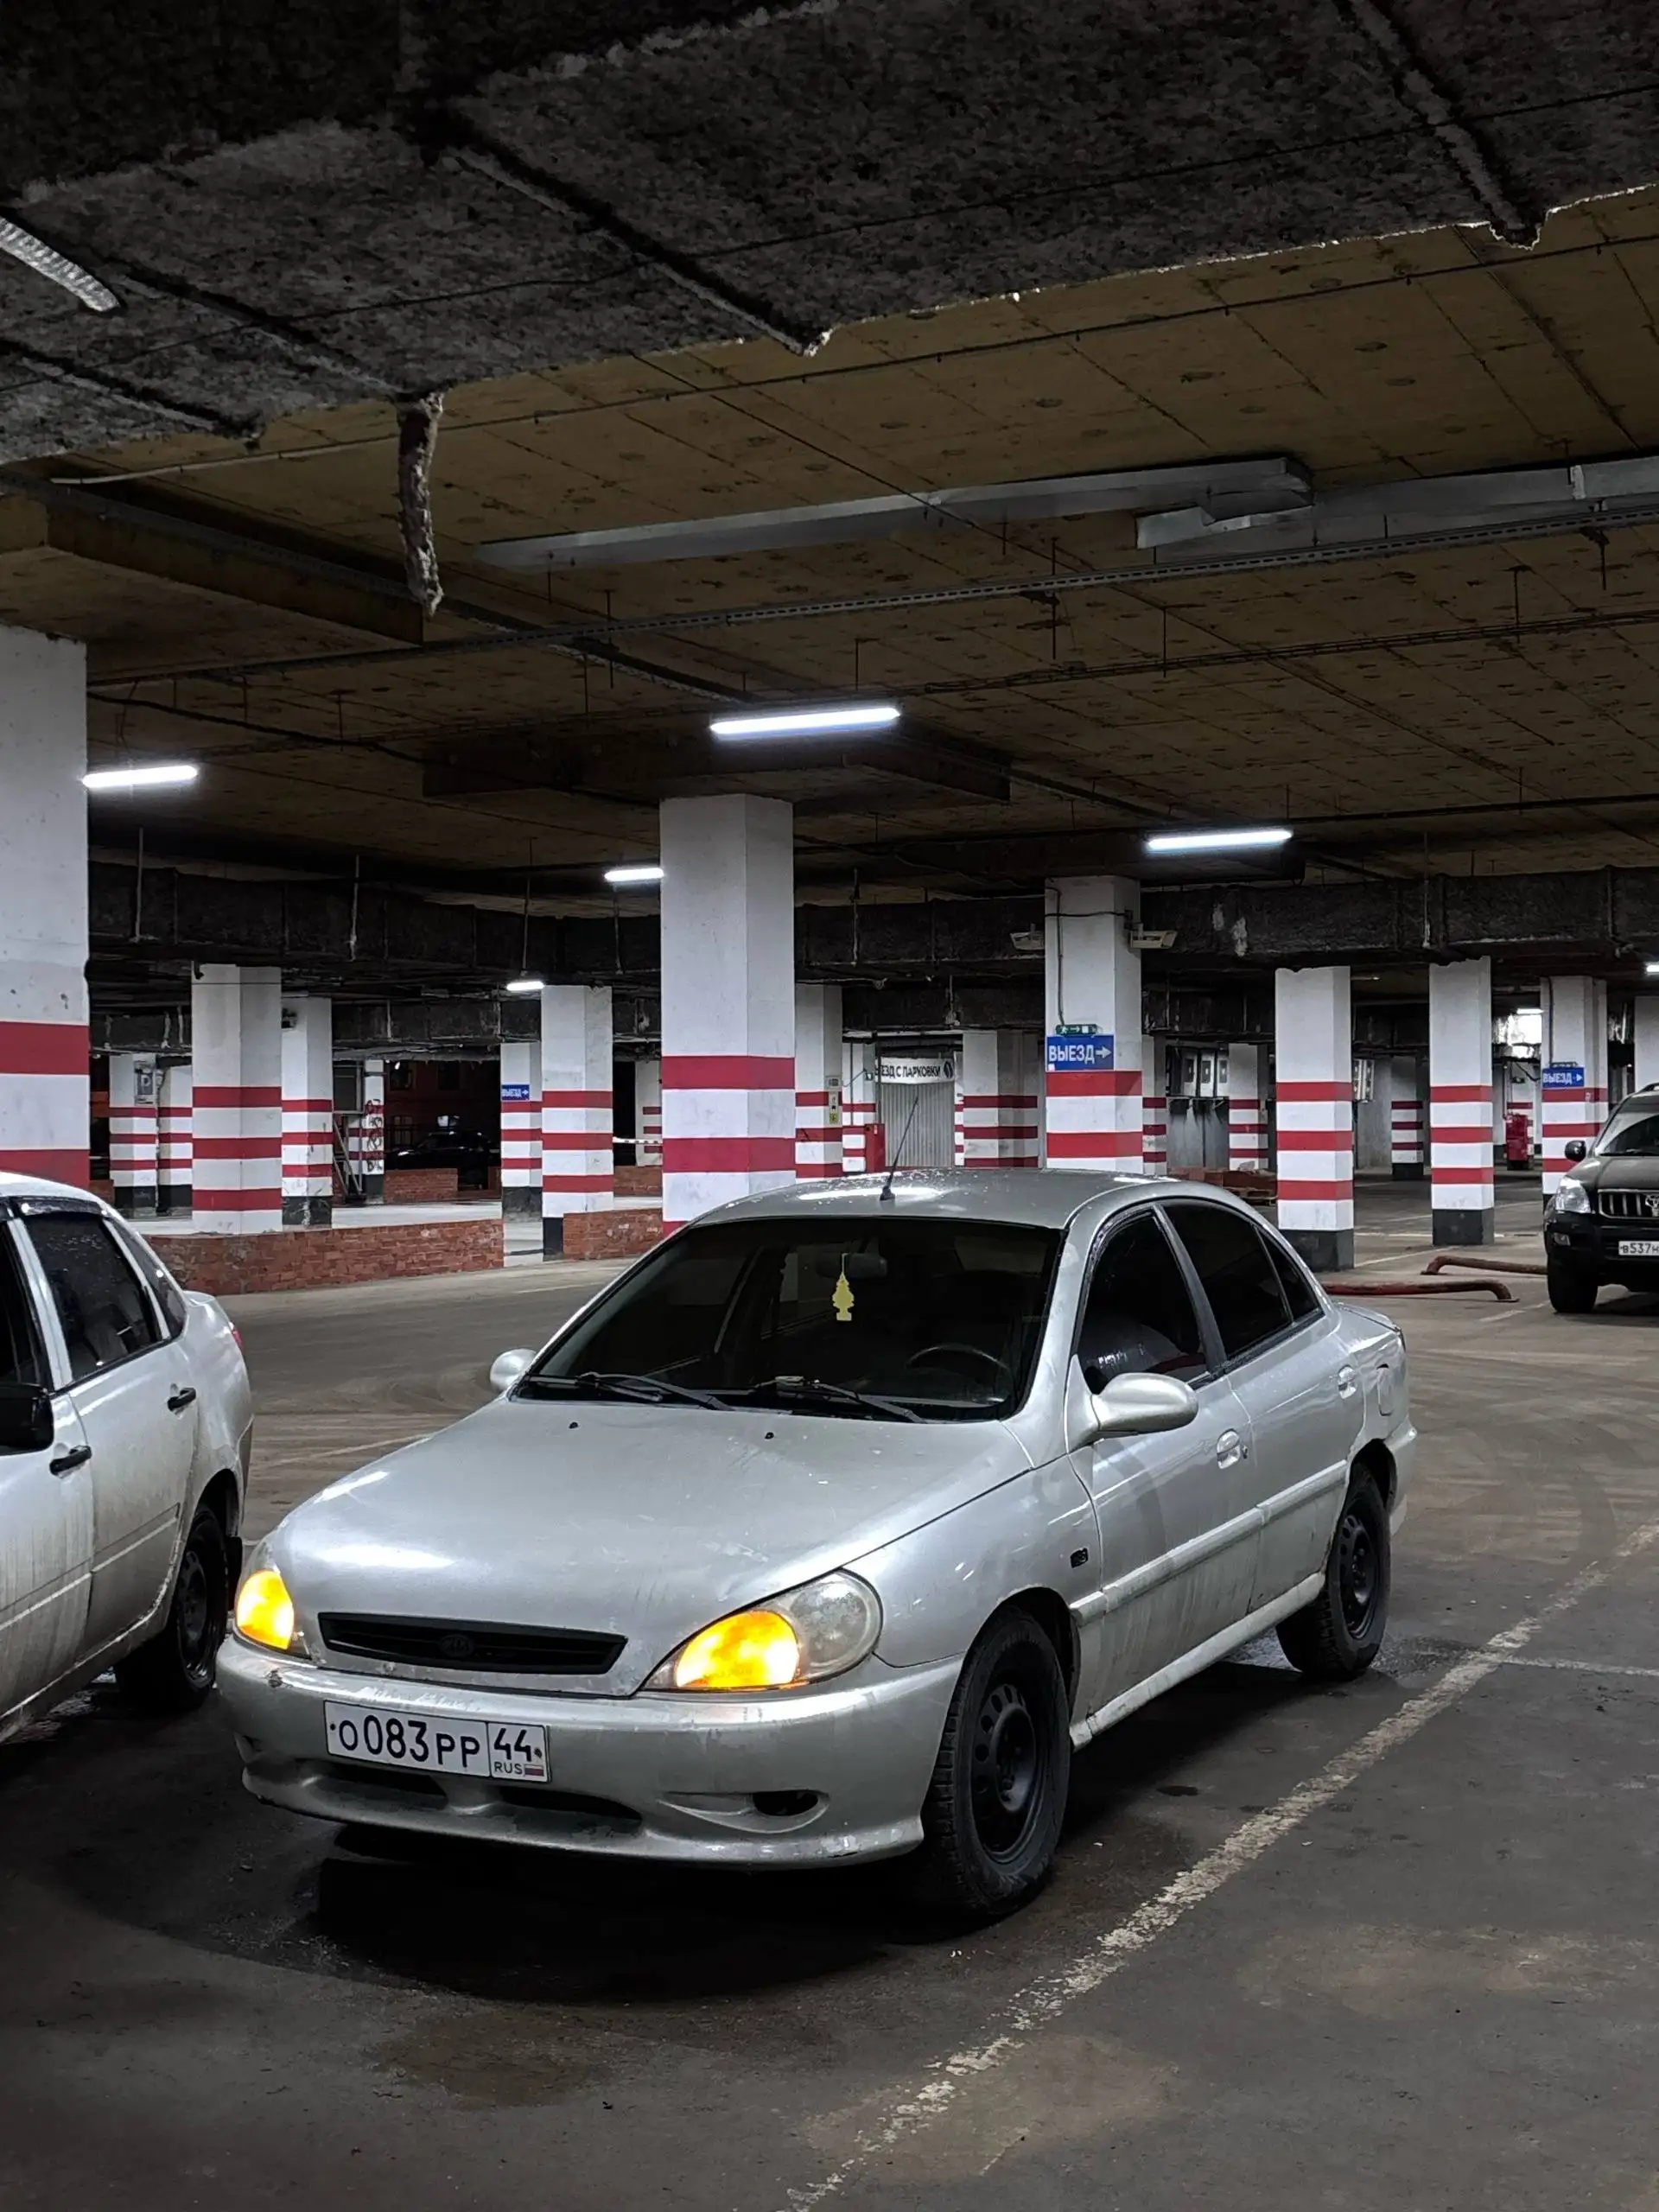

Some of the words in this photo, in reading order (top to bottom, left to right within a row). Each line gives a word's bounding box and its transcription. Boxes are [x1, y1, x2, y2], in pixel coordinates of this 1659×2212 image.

[1048, 1045, 1095, 1065] ВЫЕЗД
[903, 1065, 941, 1077] ПАРКОВКИ
[493, 1727, 531, 1762] 44
[493, 1762, 523, 1775] RUS
